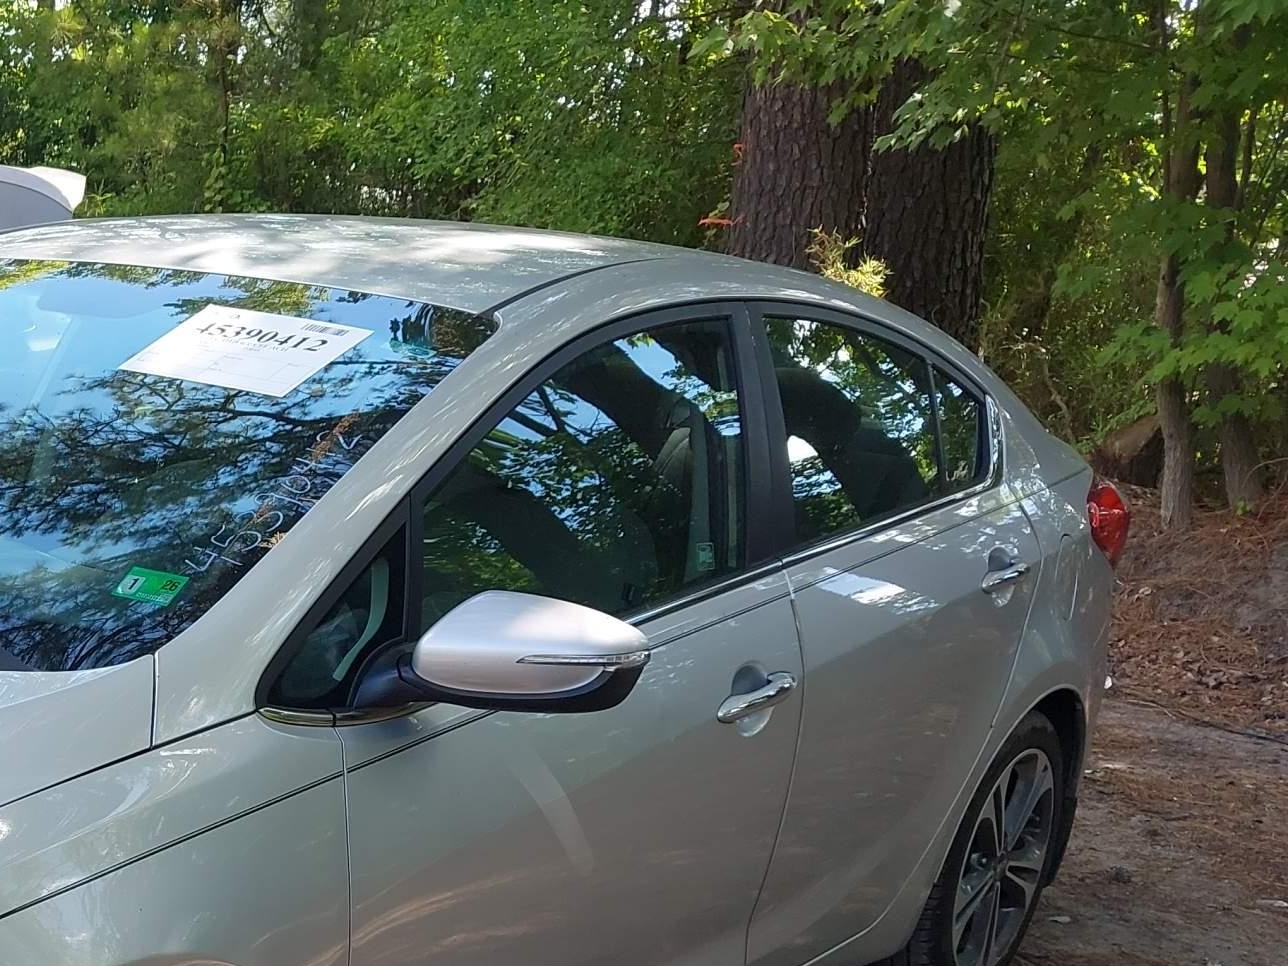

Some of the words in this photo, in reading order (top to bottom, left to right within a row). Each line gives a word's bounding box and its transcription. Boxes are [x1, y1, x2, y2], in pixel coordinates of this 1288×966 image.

[196, 322, 329, 352] 45390412
[128, 578, 140, 590] 1
[160, 579, 181, 592] 26
